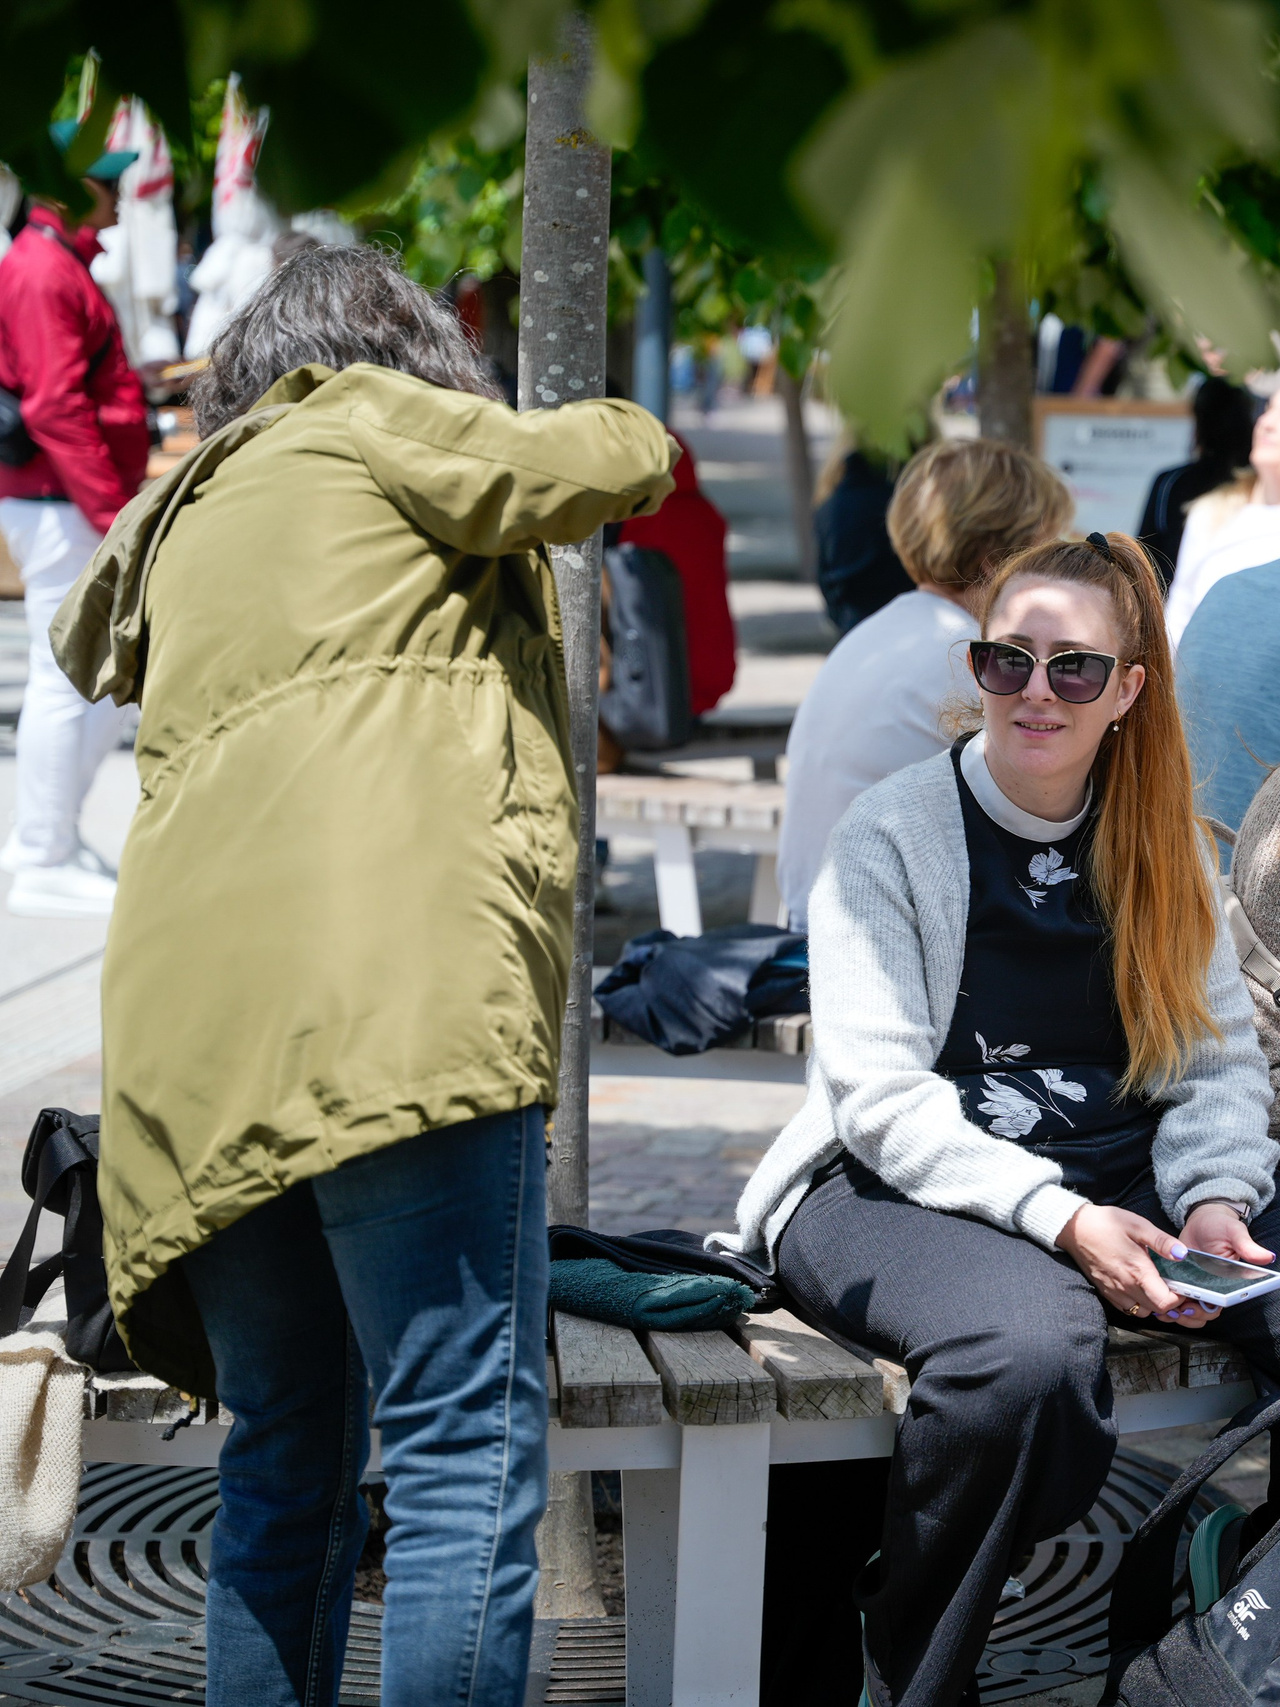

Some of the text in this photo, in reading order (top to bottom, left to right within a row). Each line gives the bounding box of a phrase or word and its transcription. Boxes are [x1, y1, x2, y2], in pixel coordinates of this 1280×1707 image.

[1233, 1600, 1256, 1621] air
[1227, 1610, 1250, 1641] comfort plus
